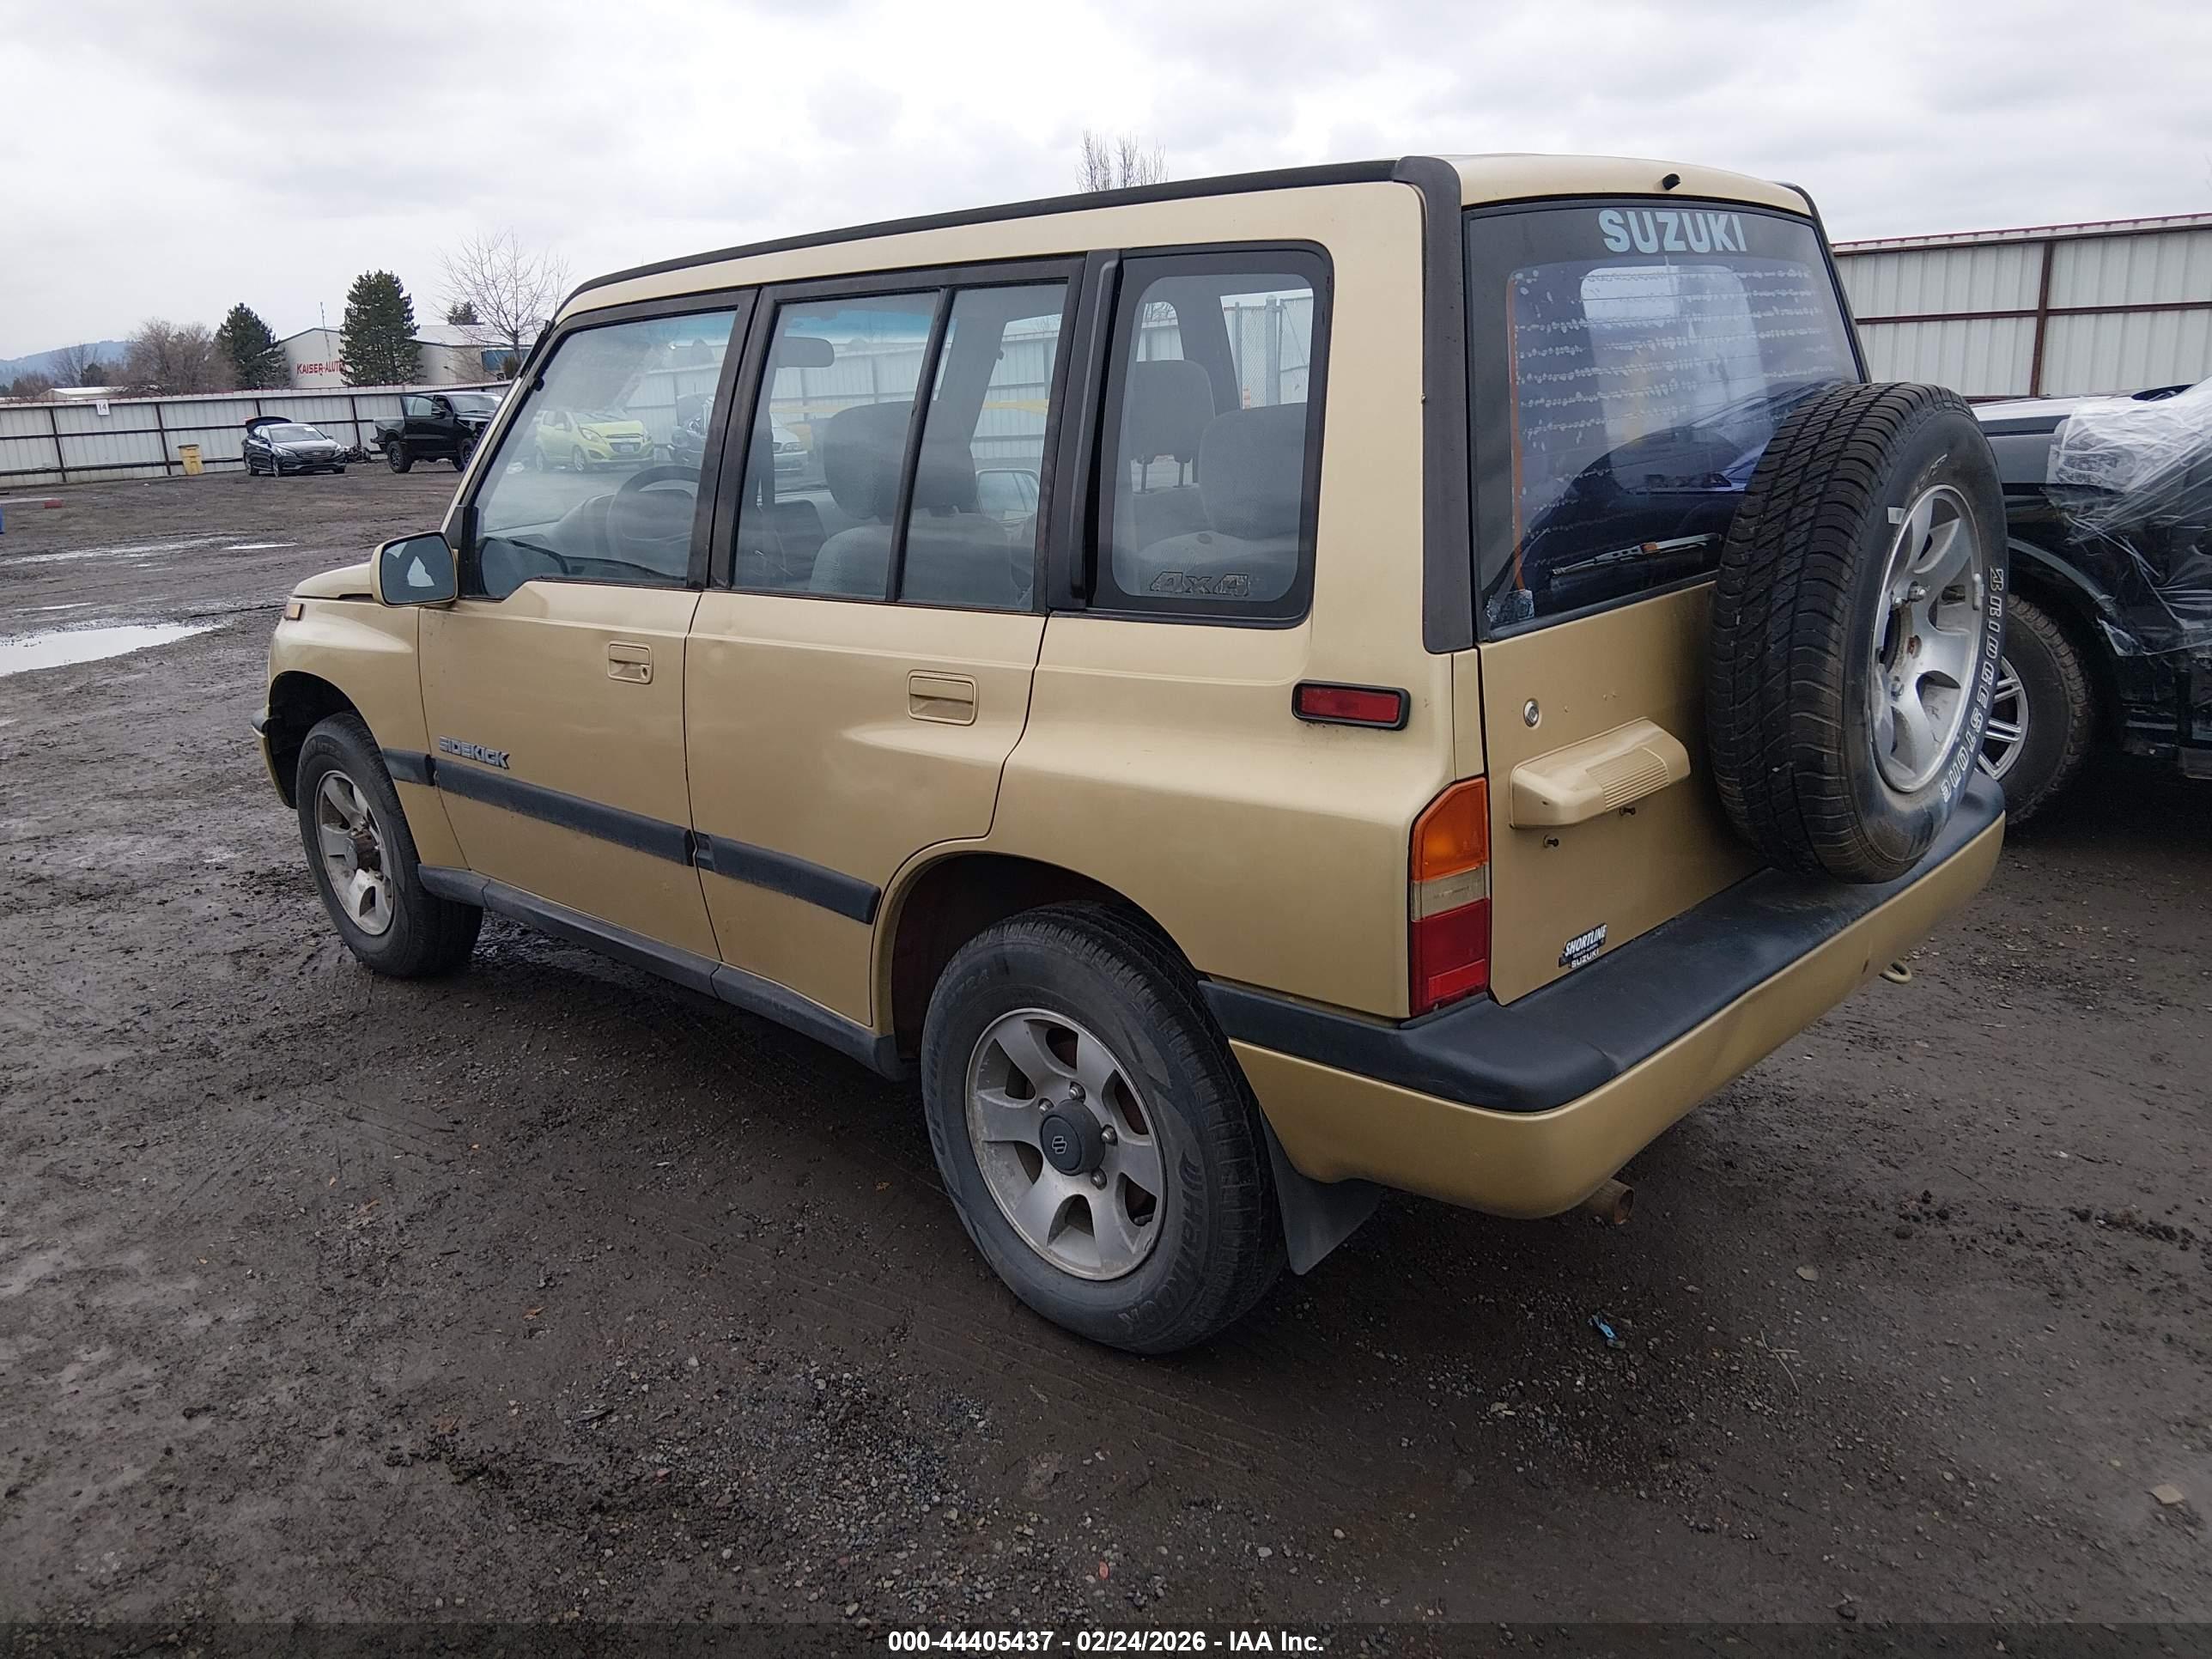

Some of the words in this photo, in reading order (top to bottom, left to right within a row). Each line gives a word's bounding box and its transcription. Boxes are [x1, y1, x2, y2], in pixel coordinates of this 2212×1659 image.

[1598, 210, 1747, 254] SUZUKI
[98, 403, 107, 412] 14
[1940, 567, 2005, 803] BRIDGESTONE
[439, 736, 511, 769] SIDEKICK
[1565, 923, 1607, 957] SHORTLINE
[1571, 947, 1600, 969] SUZUKI
